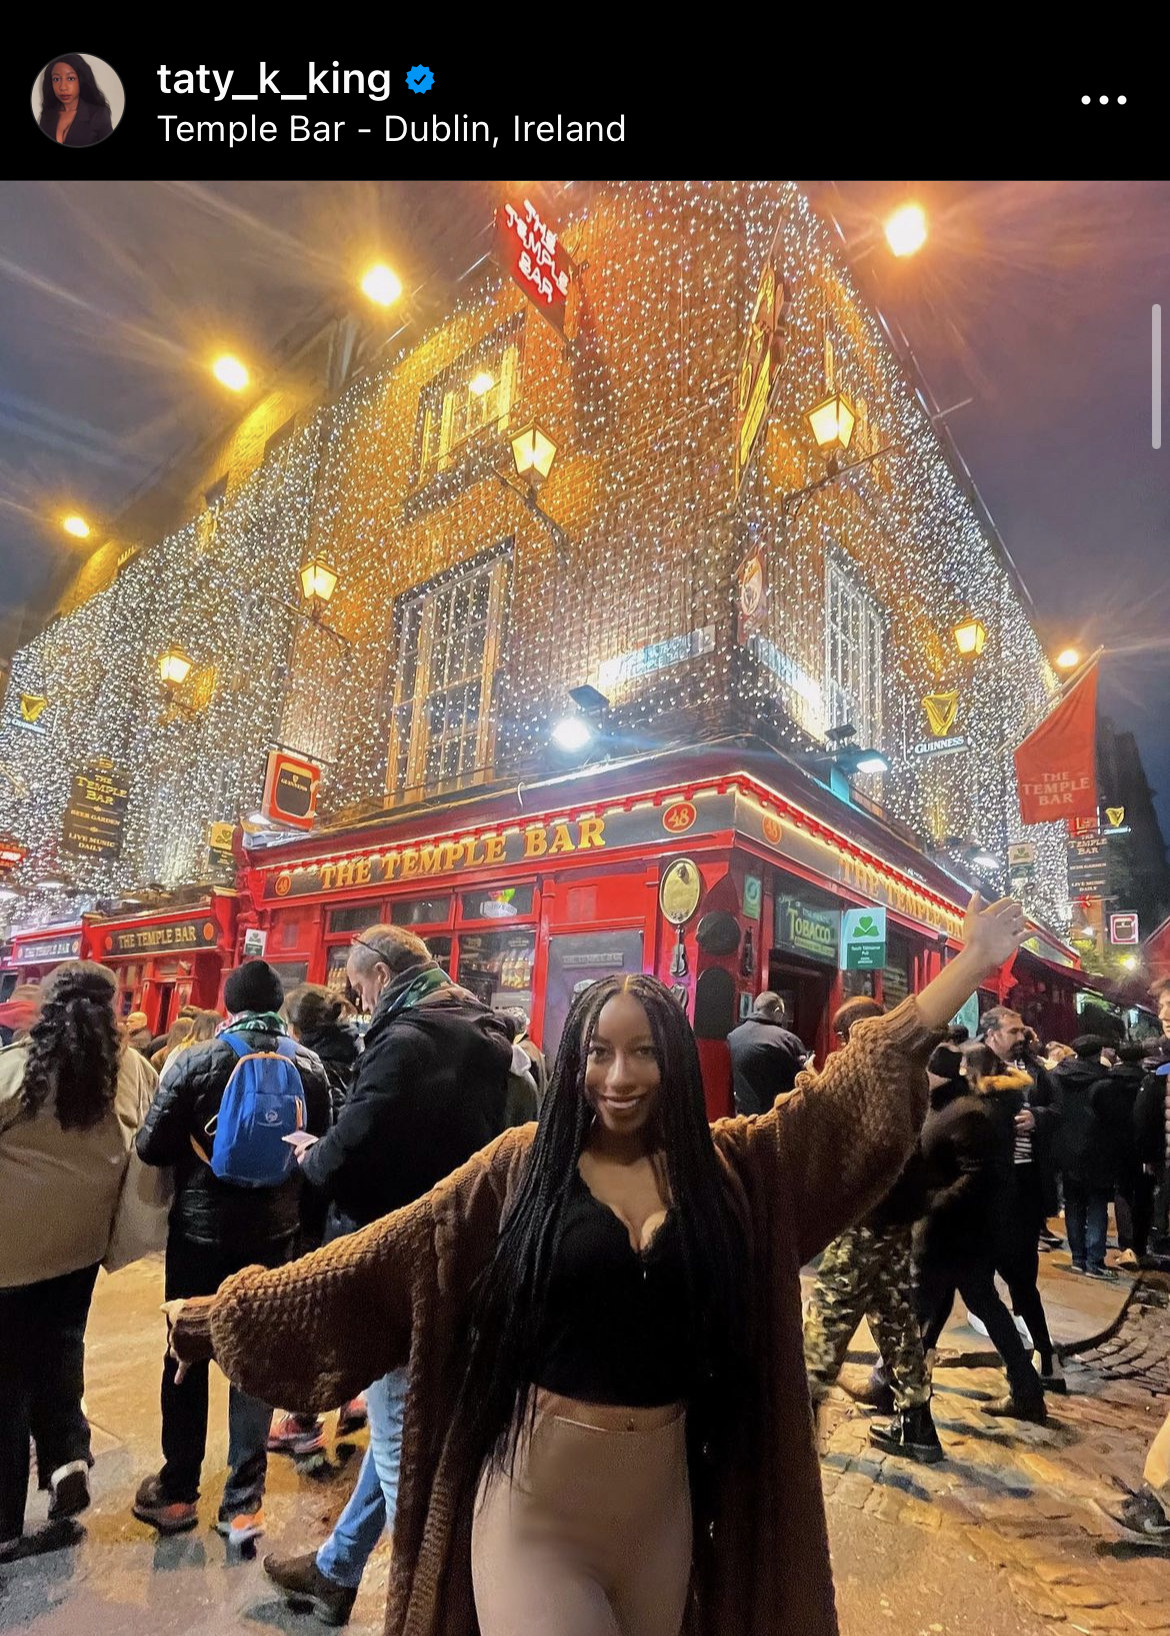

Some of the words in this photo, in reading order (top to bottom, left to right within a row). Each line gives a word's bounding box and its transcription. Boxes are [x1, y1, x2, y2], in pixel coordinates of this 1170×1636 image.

[523, 199, 558, 256] THE
[504, 203, 569, 296] TEMPLE
[518, 251, 554, 304] BAR
[914, 735, 965, 755] GUINNESS
[94, 774, 113, 785] THE
[1041, 771, 1070, 782] THE
[75, 775, 128, 799] TEMPLE
[1021, 777, 1091, 796] TEMPLE
[86, 789, 114, 806] BAR
[1039, 792, 1073, 806] BAR
[668, 807, 690, 829] 48
[68, 832, 88, 843] LIVE
[1067, 838, 1108, 849] TEMPLE
[78, 842, 104, 853] DAILY
[320, 858, 372, 890] THE
[381, 835, 507, 880] TEMPLE
[523, 817, 606, 858] BAR
[1077, 846, 1099, 856] BAR
[837, 859, 880, 898] THE
[119, 933, 135, 949] THE
[136, 928, 173, 947] TEMPLE
[174, 925, 197, 943] BAR
